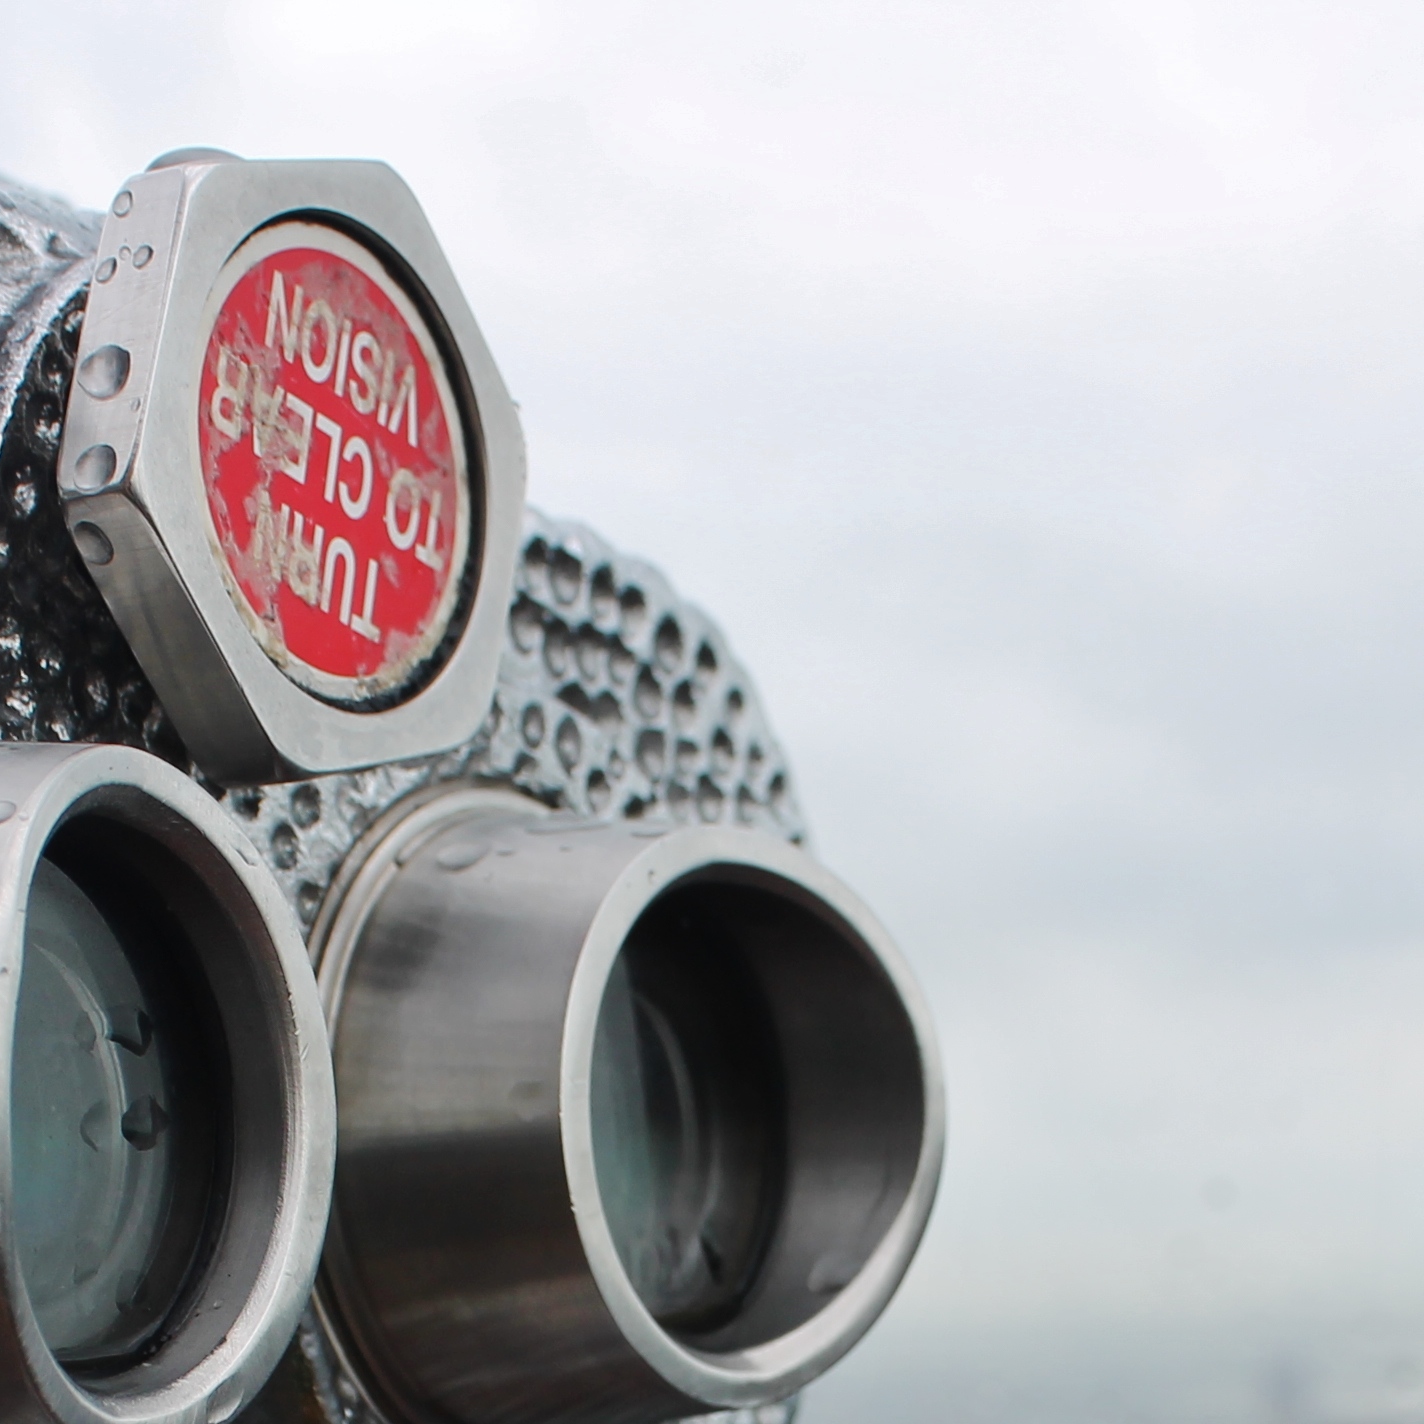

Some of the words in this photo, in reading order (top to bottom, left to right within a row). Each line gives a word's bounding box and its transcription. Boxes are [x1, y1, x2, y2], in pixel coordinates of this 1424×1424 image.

[264, 269, 419, 447] VISION
[251, 489, 381, 644] TURN
[384, 467, 446, 571] TO
